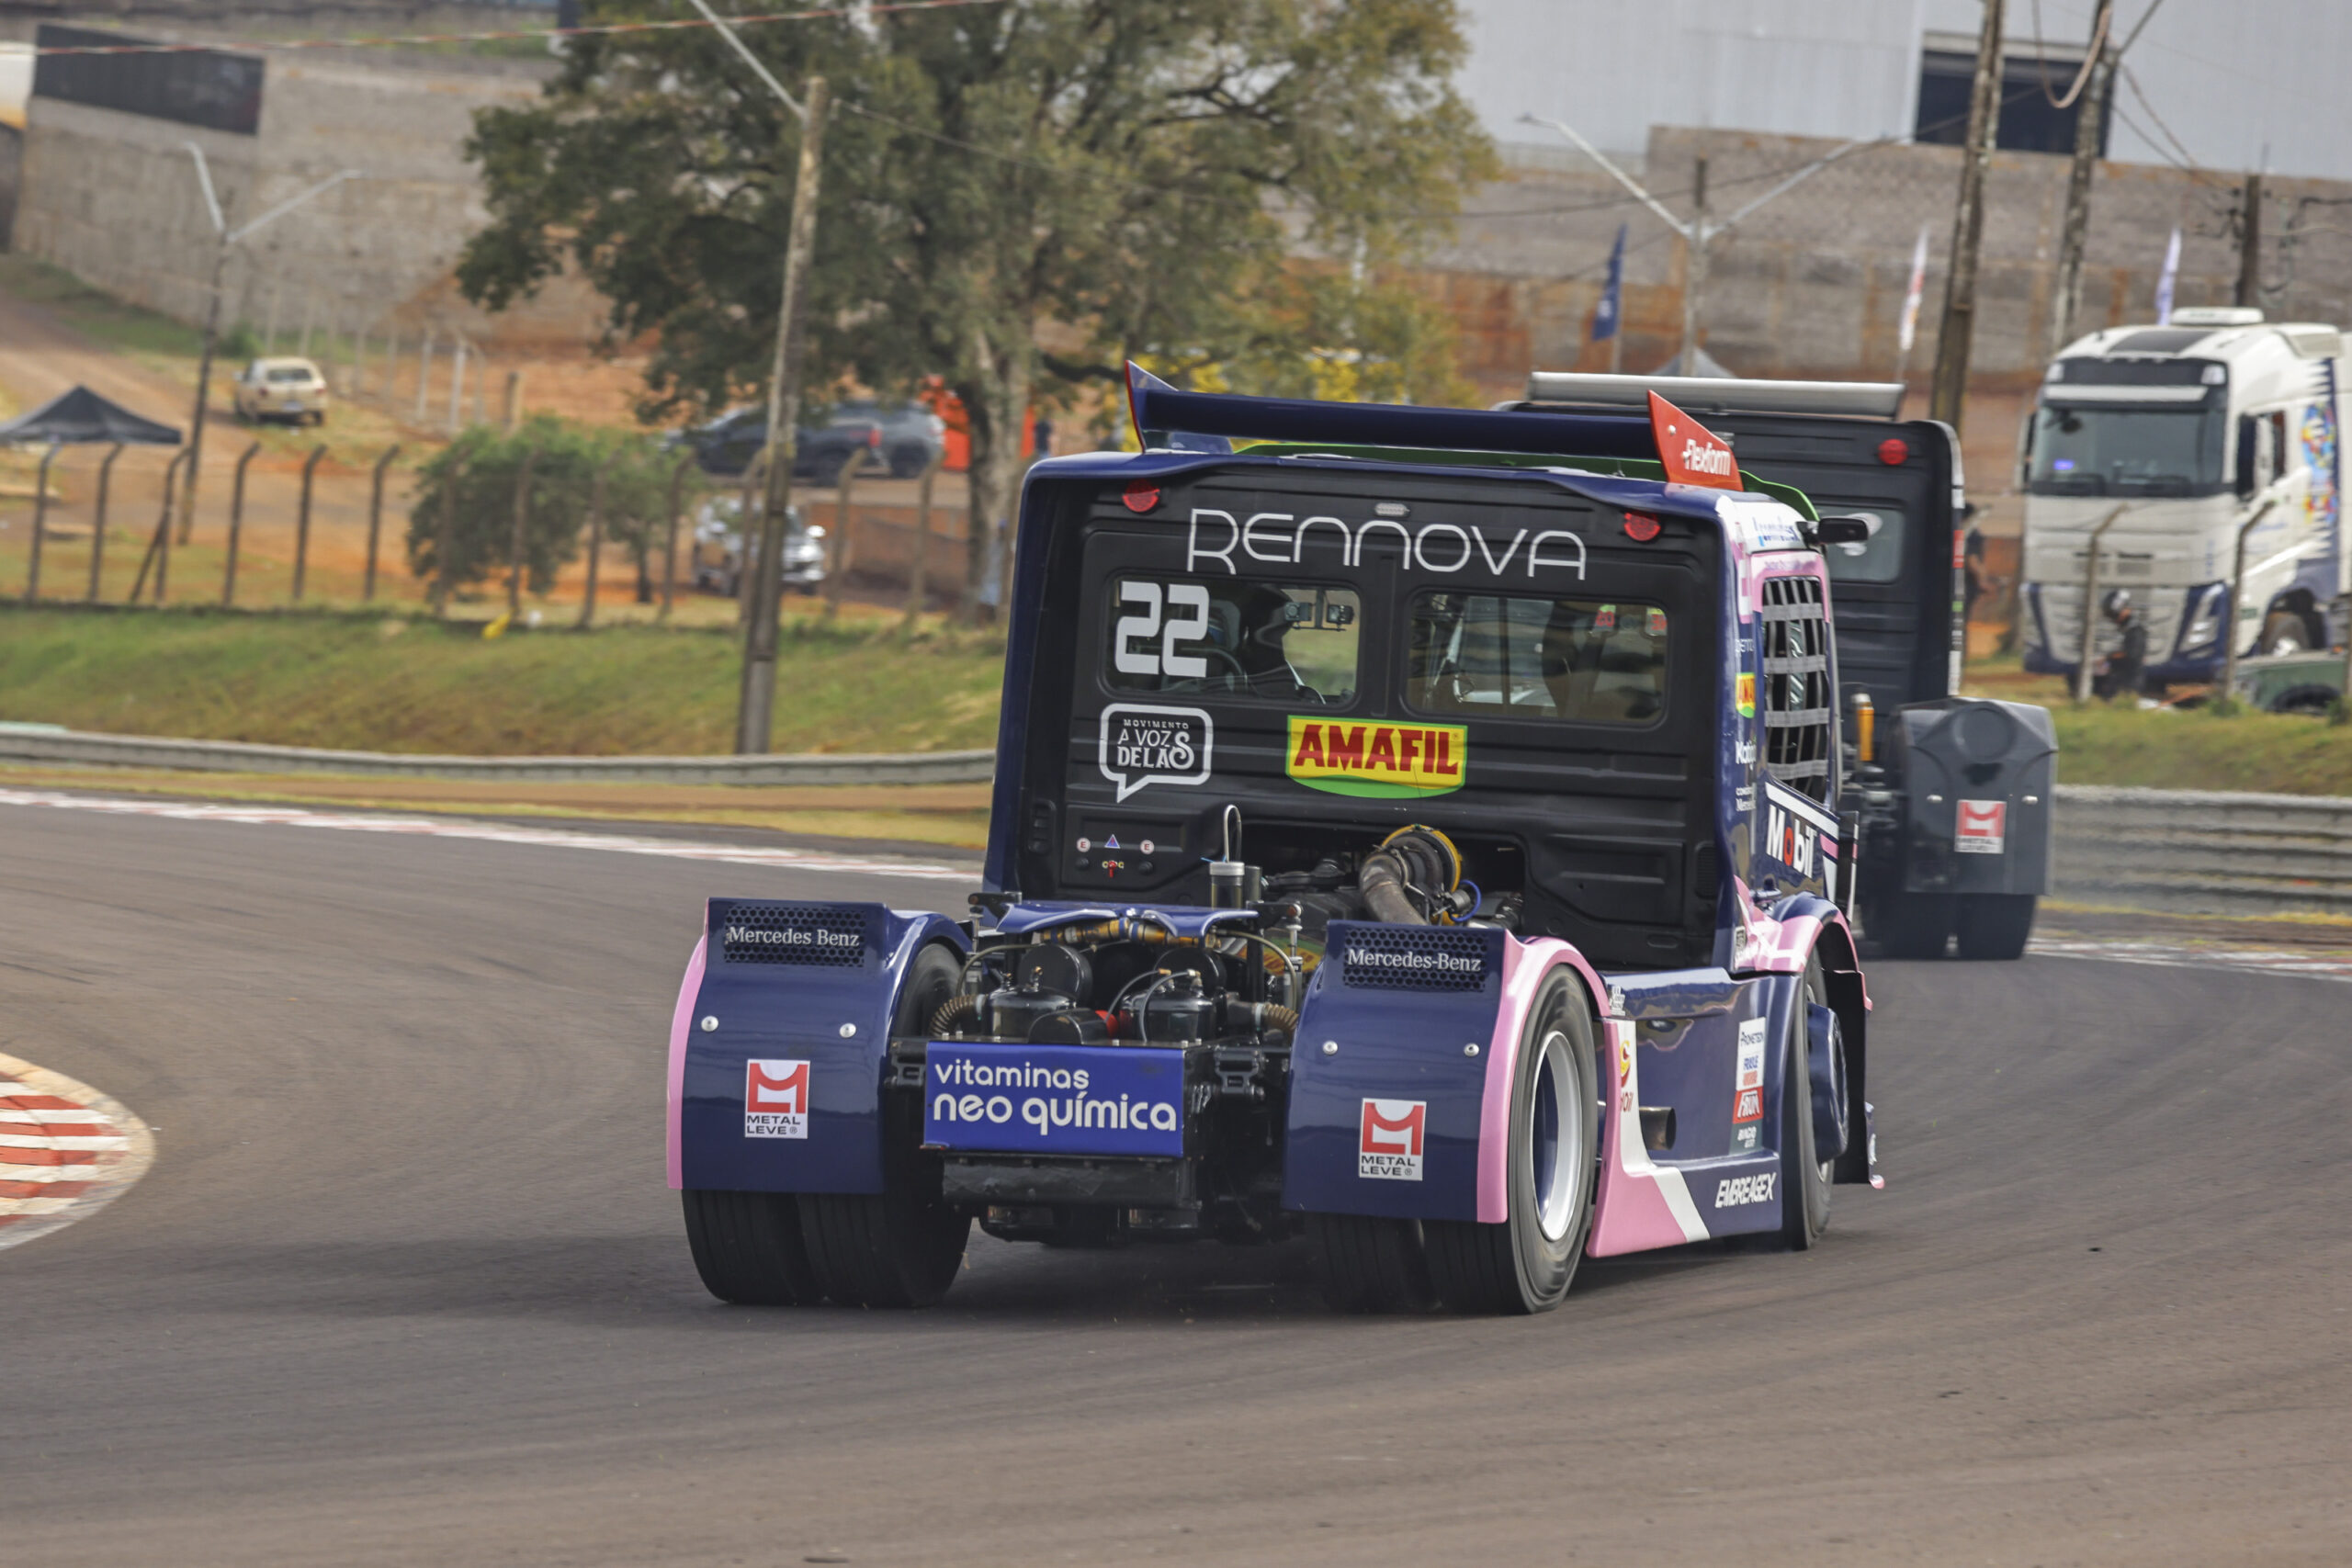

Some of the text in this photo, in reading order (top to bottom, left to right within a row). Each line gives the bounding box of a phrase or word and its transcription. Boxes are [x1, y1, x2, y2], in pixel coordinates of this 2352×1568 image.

[1115, 581, 1210, 678] 22
[1124, 719, 1189, 729] MOVIMENTO
[1117, 728, 1172, 748] A VOZ
[1117, 731, 1194, 770] DELAS
[1294, 724, 1459, 775] AMAFIL
[1767, 804, 1817, 879] Mobil
[729, 926, 860, 947] Mercedes Benz
[1348, 949, 1482, 972] Mercedes-Benz
[934, 1059, 1090, 1089] vitaminas
[747, 1115, 801, 1125] METAL
[933, 1091, 1177, 1136] neo química
[747, 1125, 787, 1135] LEVE
[1361, 1156, 1416, 1167] METAL
[1361, 1166, 1402, 1177] LEVE
